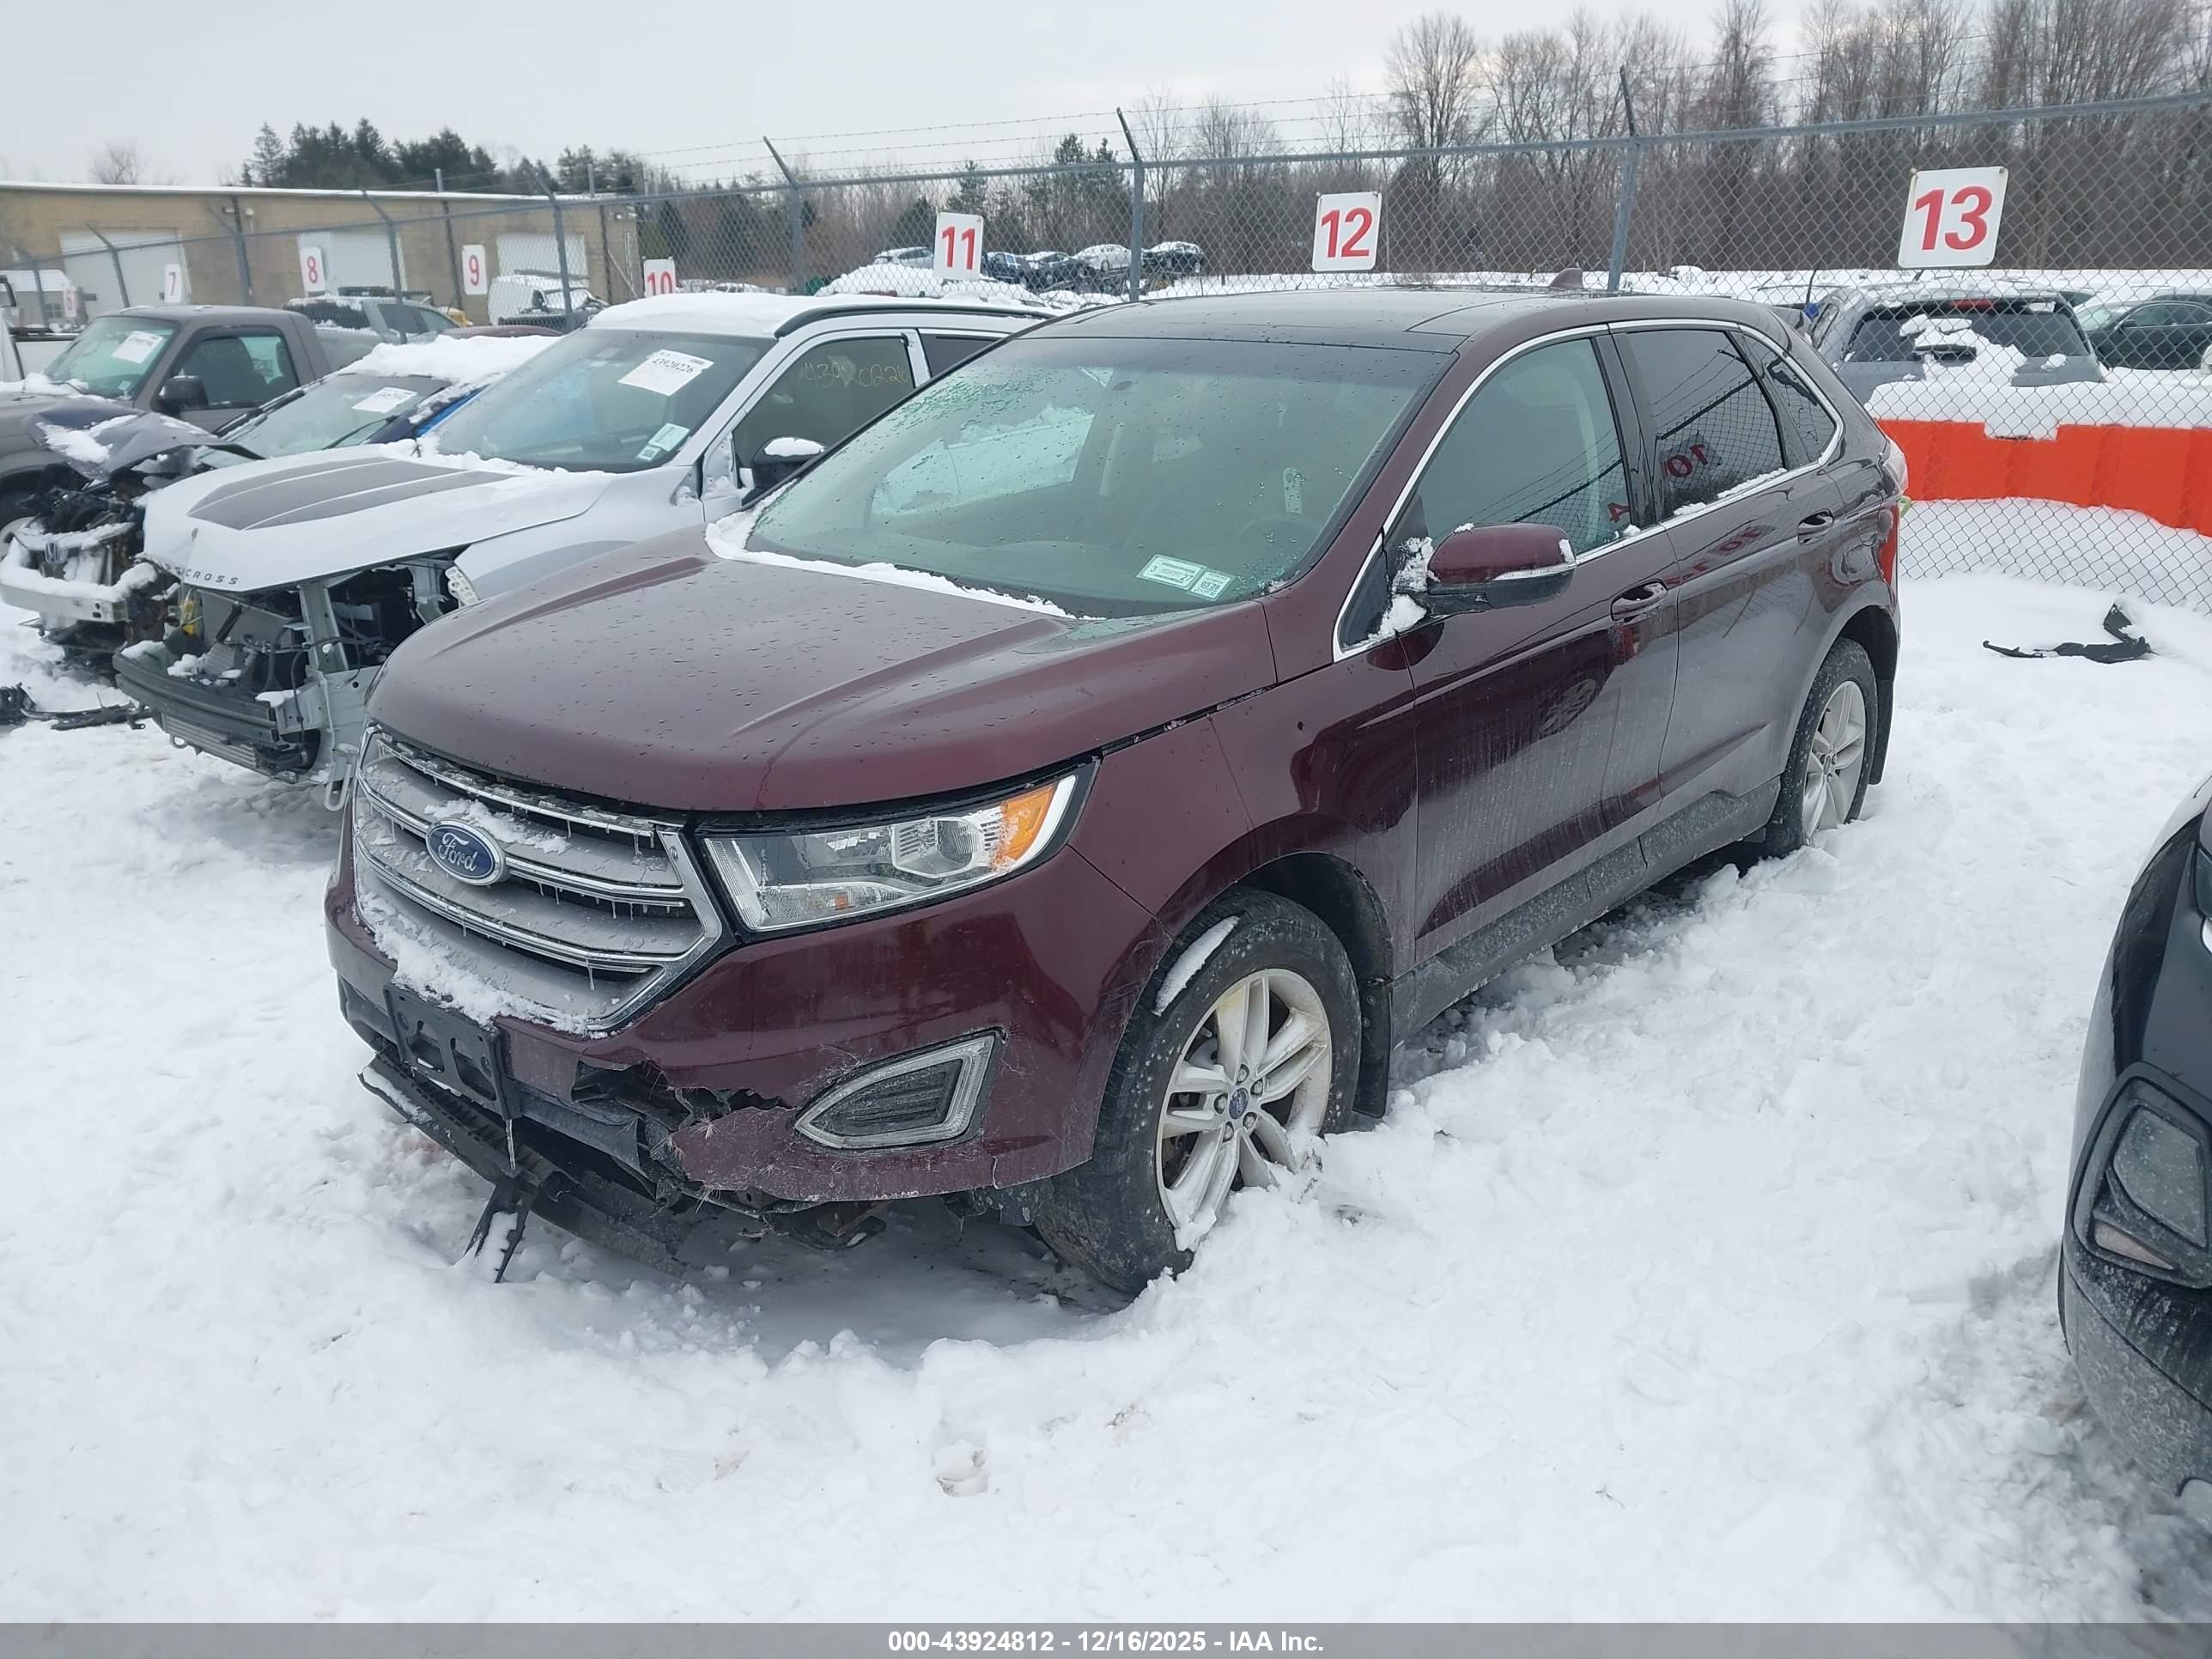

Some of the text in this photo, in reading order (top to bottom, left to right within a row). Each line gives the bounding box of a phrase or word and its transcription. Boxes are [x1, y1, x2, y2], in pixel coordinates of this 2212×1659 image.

[1321, 207, 1373, 258] 12
[1914, 185, 1993, 251] 13
[941, 226, 975, 270] 11
[168, 271, 176, 296] 7
[307, 256, 318, 284] 8
[468, 254, 479, 286] 9
[647, 270, 673, 295] 10
[438, 832, 479, 872] Ford
